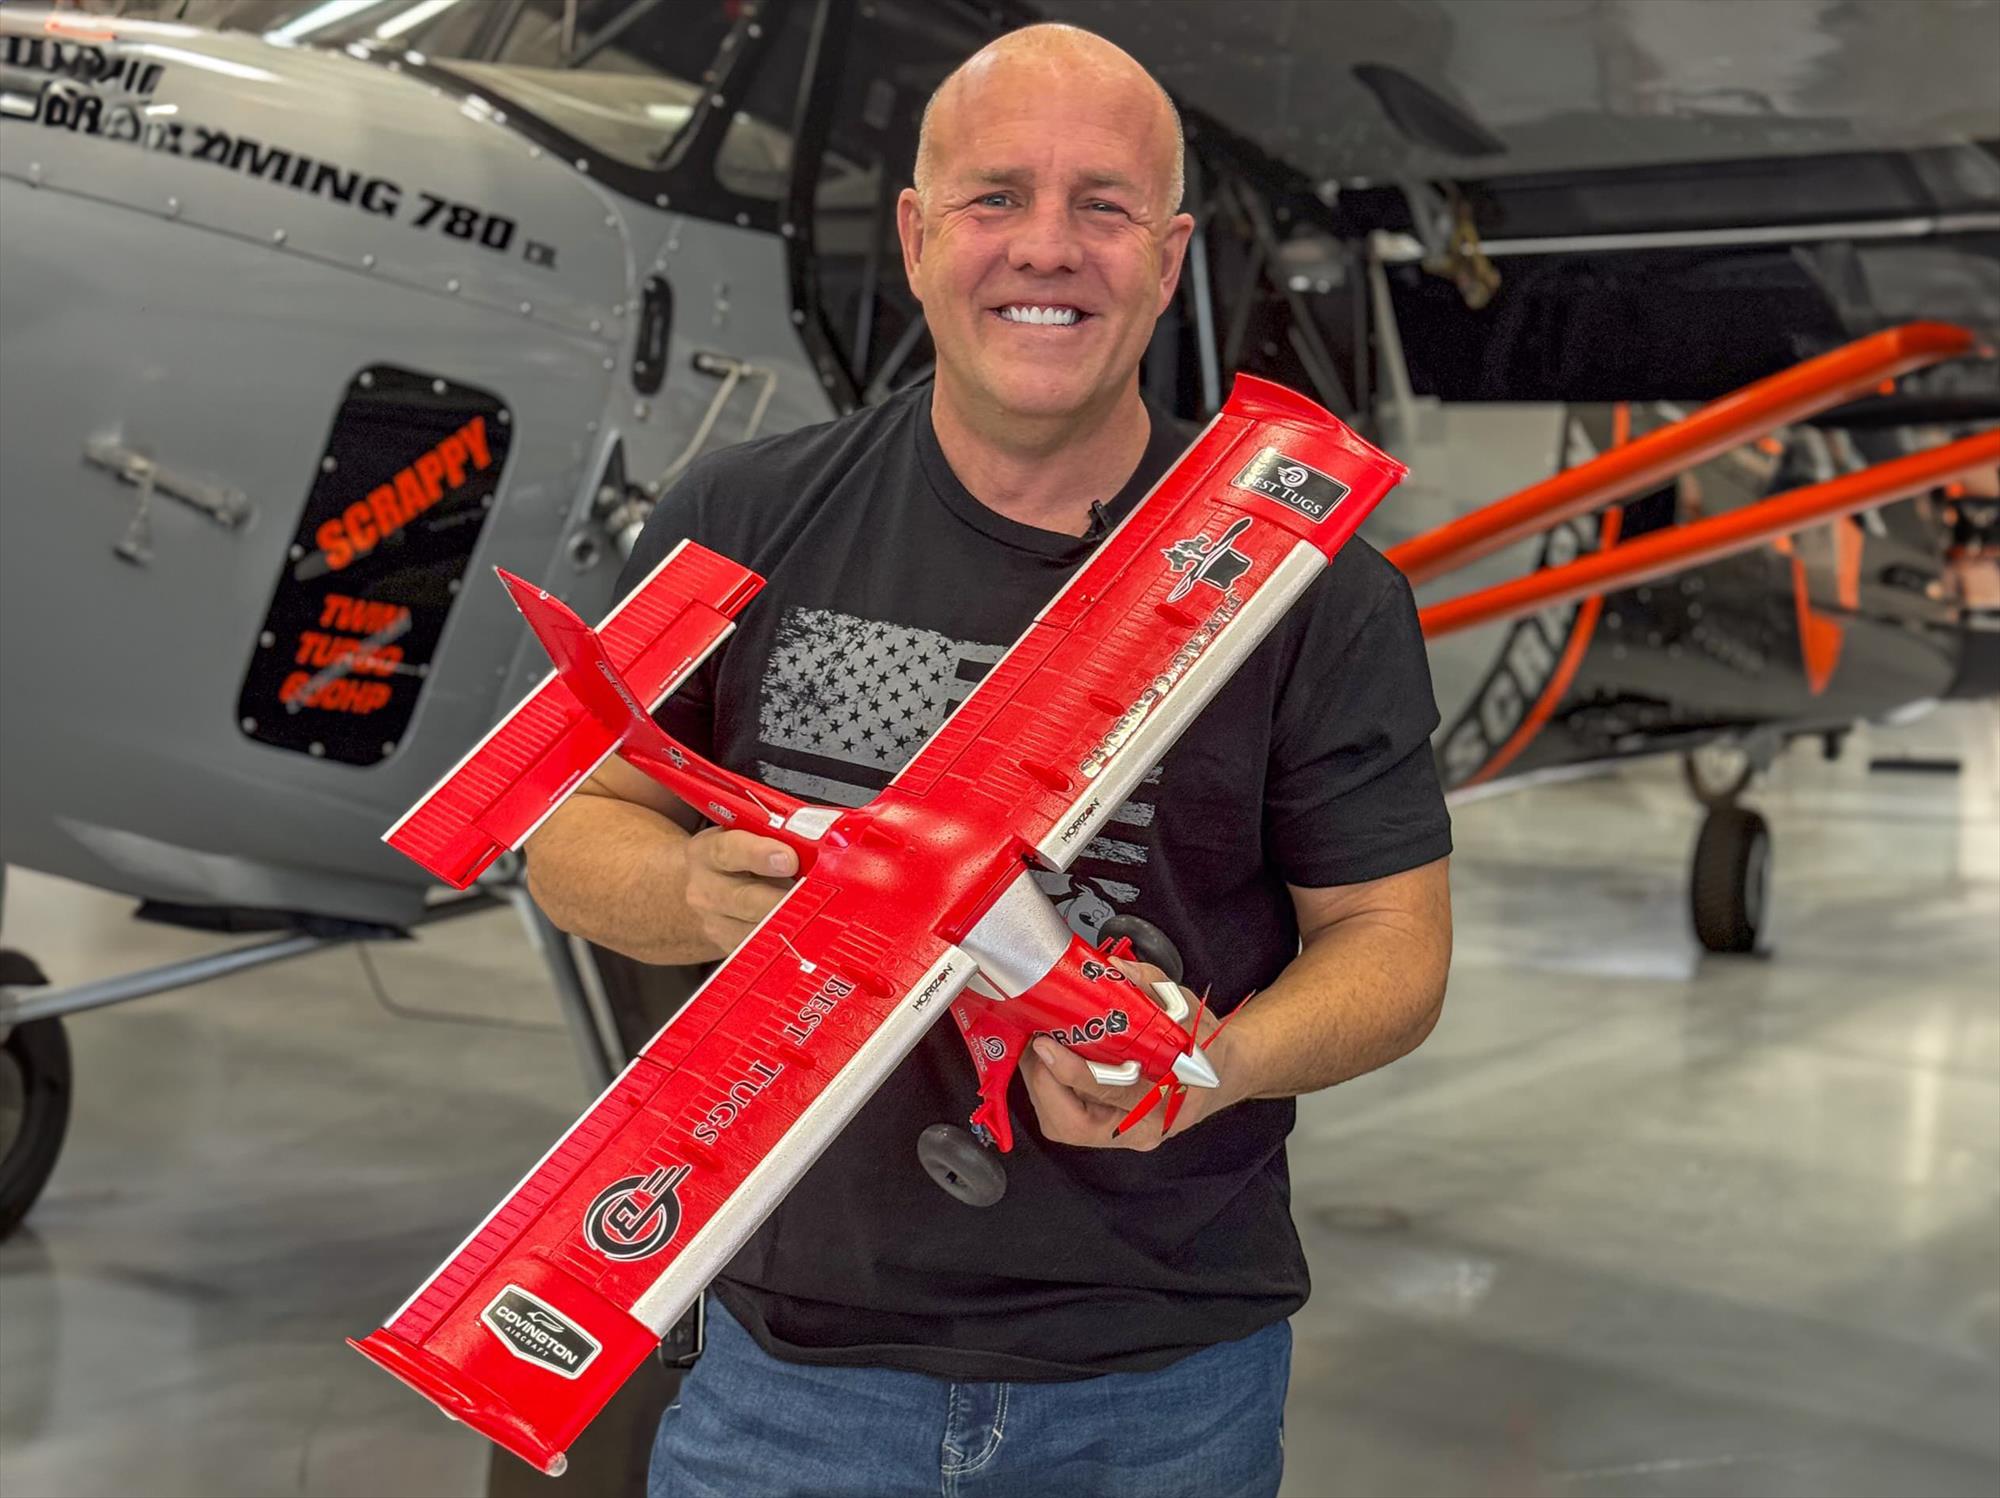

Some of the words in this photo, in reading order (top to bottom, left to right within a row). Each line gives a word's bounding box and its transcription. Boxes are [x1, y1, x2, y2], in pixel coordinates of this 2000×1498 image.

[411, 191, 517, 252] 780
[315, 415, 492, 571] SCRAPPY
[1281, 486, 1323, 515] TUGS
[319, 592, 411, 634] TWIN
[1061, 797, 1100, 843] HORIZON
[783, 974, 857, 1046] BEST
[912, 962, 953, 1010] HORIZON
[692, 1059, 785, 1146] TUGS
[495, 1305, 579, 1365] COVINGTON
[504, 1326, 550, 1357] AIRCRAFT
